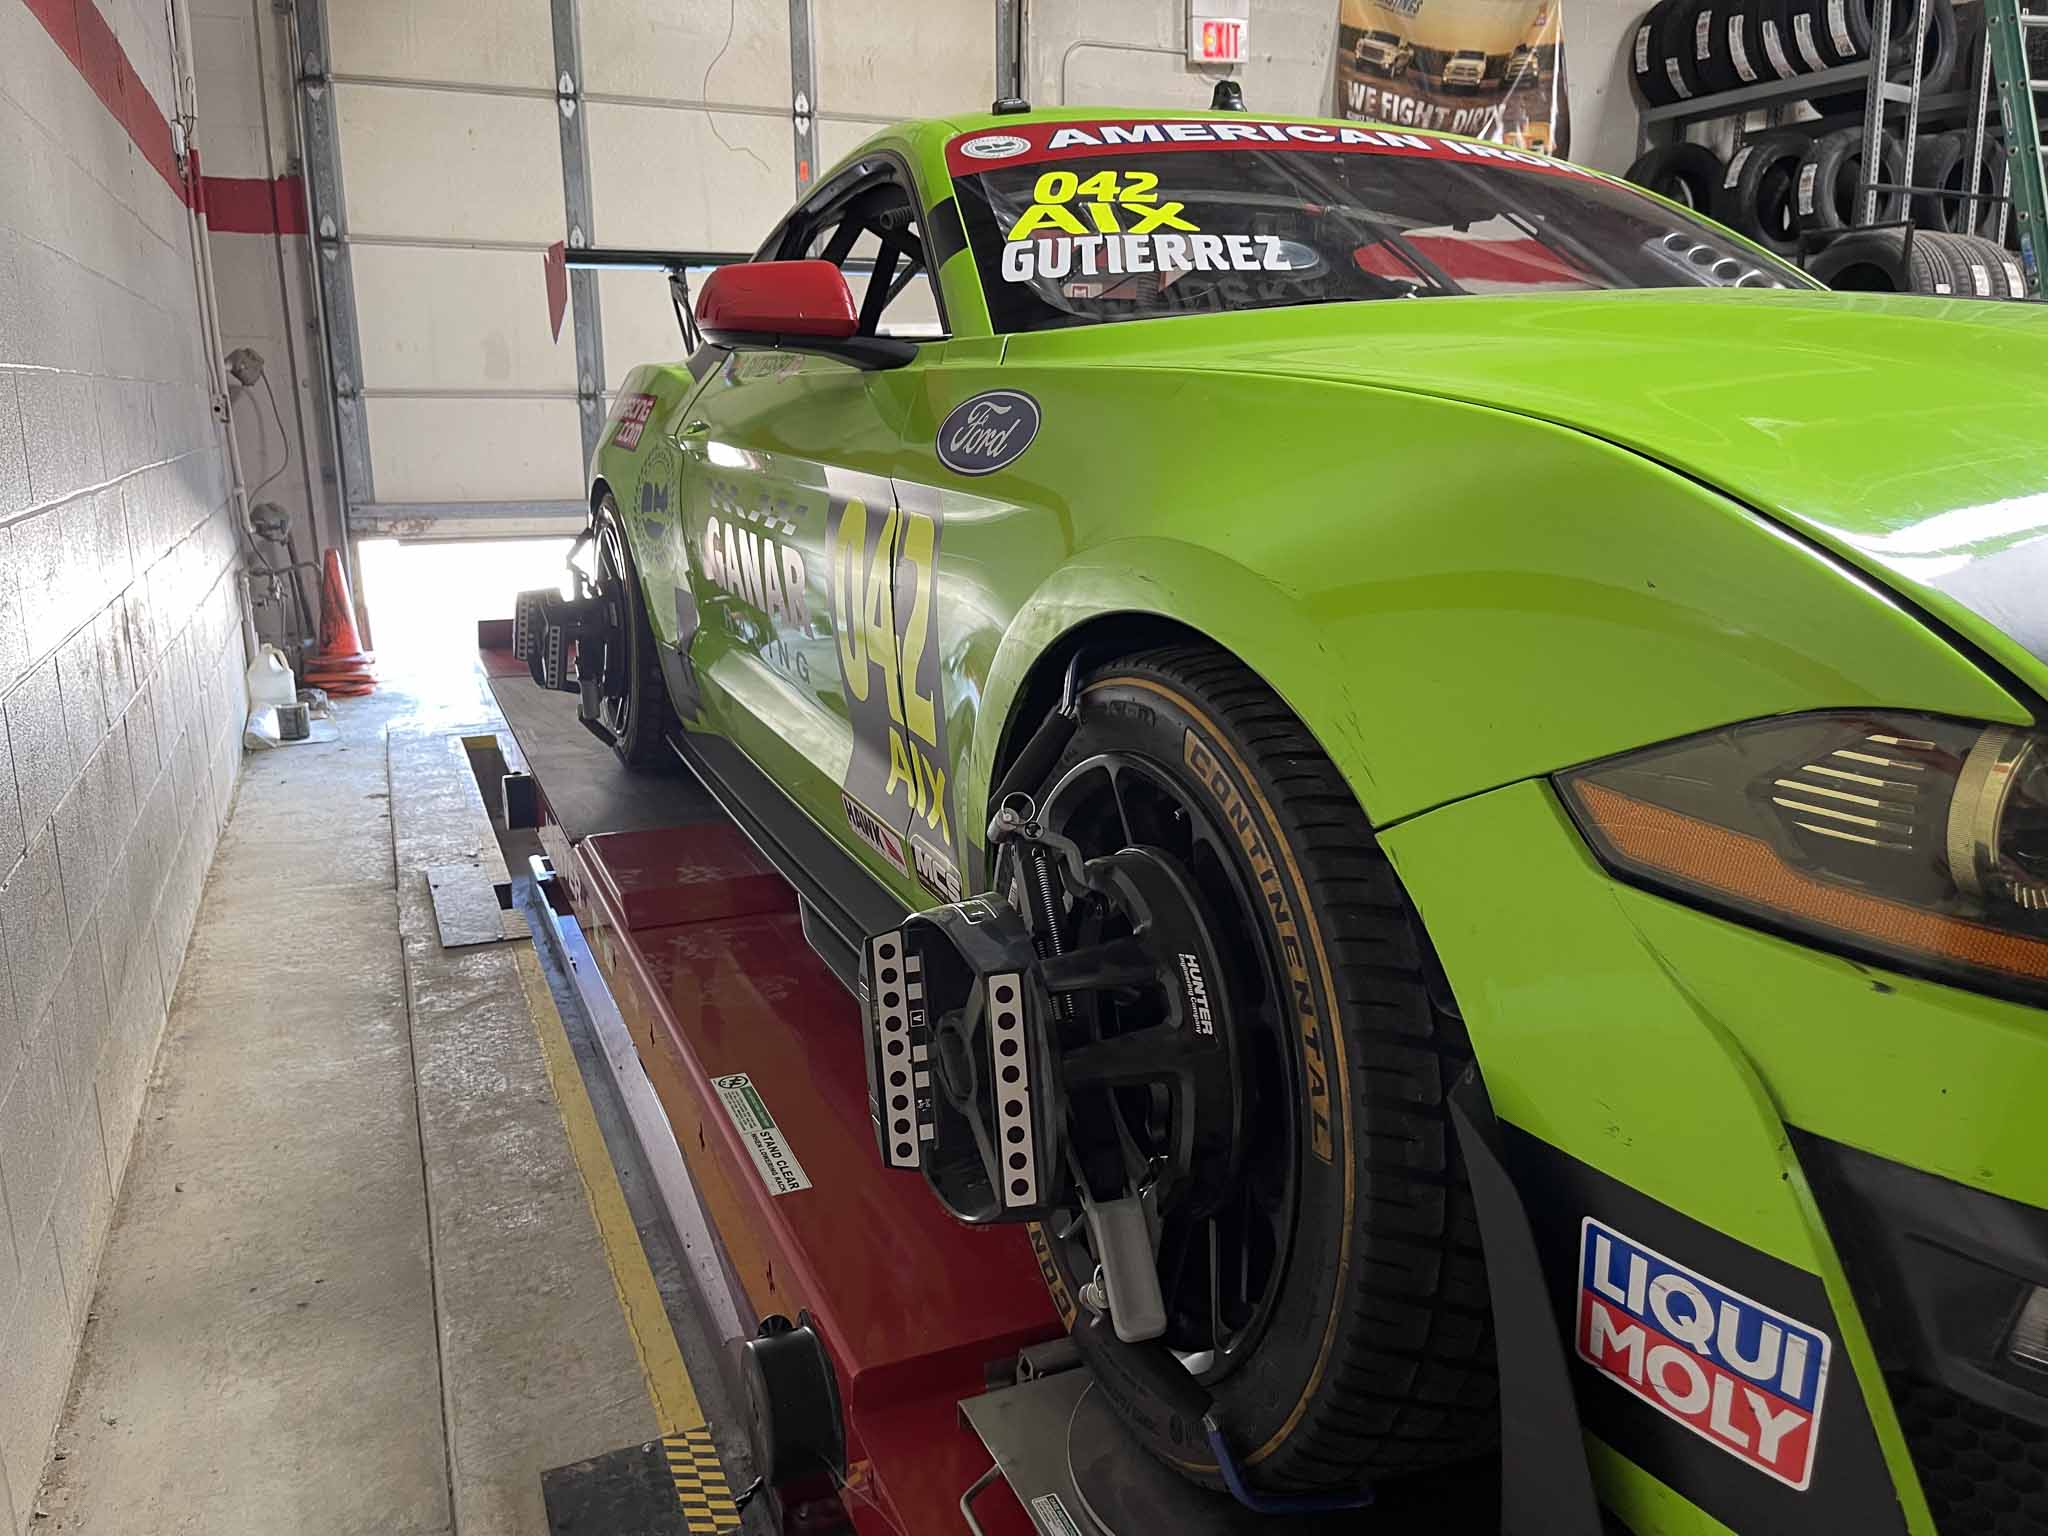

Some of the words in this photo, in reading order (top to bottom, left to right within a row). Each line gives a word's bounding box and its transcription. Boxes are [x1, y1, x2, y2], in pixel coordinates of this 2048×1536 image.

[1203, 22, 1240, 59] EXIT
[1348, 79, 1377, 113] WE
[1380, 91, 1450, 131] FIGHT
[1048, 122, 1432, 151] AMERICAN
[1033, 170, 1158, 204] 042
[1007, 201, 1201, 241] AIX
[1001, 234, 1292, 282] GUTIERREZ
[950, 401, 1021, 458] Ford
[834, 496, 937, 748] 042
[885, 726, 950, 847] AIX
[843, 798, 884, 851] HAWK
[911, 844, 961, 903] MCS
[1190, 743, 1334, 1153] CONTINENTAL
[1178, 953, 1195, 996] Engineering
[1190, 996, 1203, 1034] Company
[1185, 953, 1214, 1035] HUNTER
[751, 1132, 764, 1149] WHEN
[759, 1146, 778, 1176] LOWERING
[775, 1175, 788, 1193] RACK
[760, 1130, 783, 1159] STAND
[776, 1159, 800, 1190] CLEAR
[1593, 1234, 1809, 1400] LIQUI
[1590, 1301, 1807, 1465] MOLY
